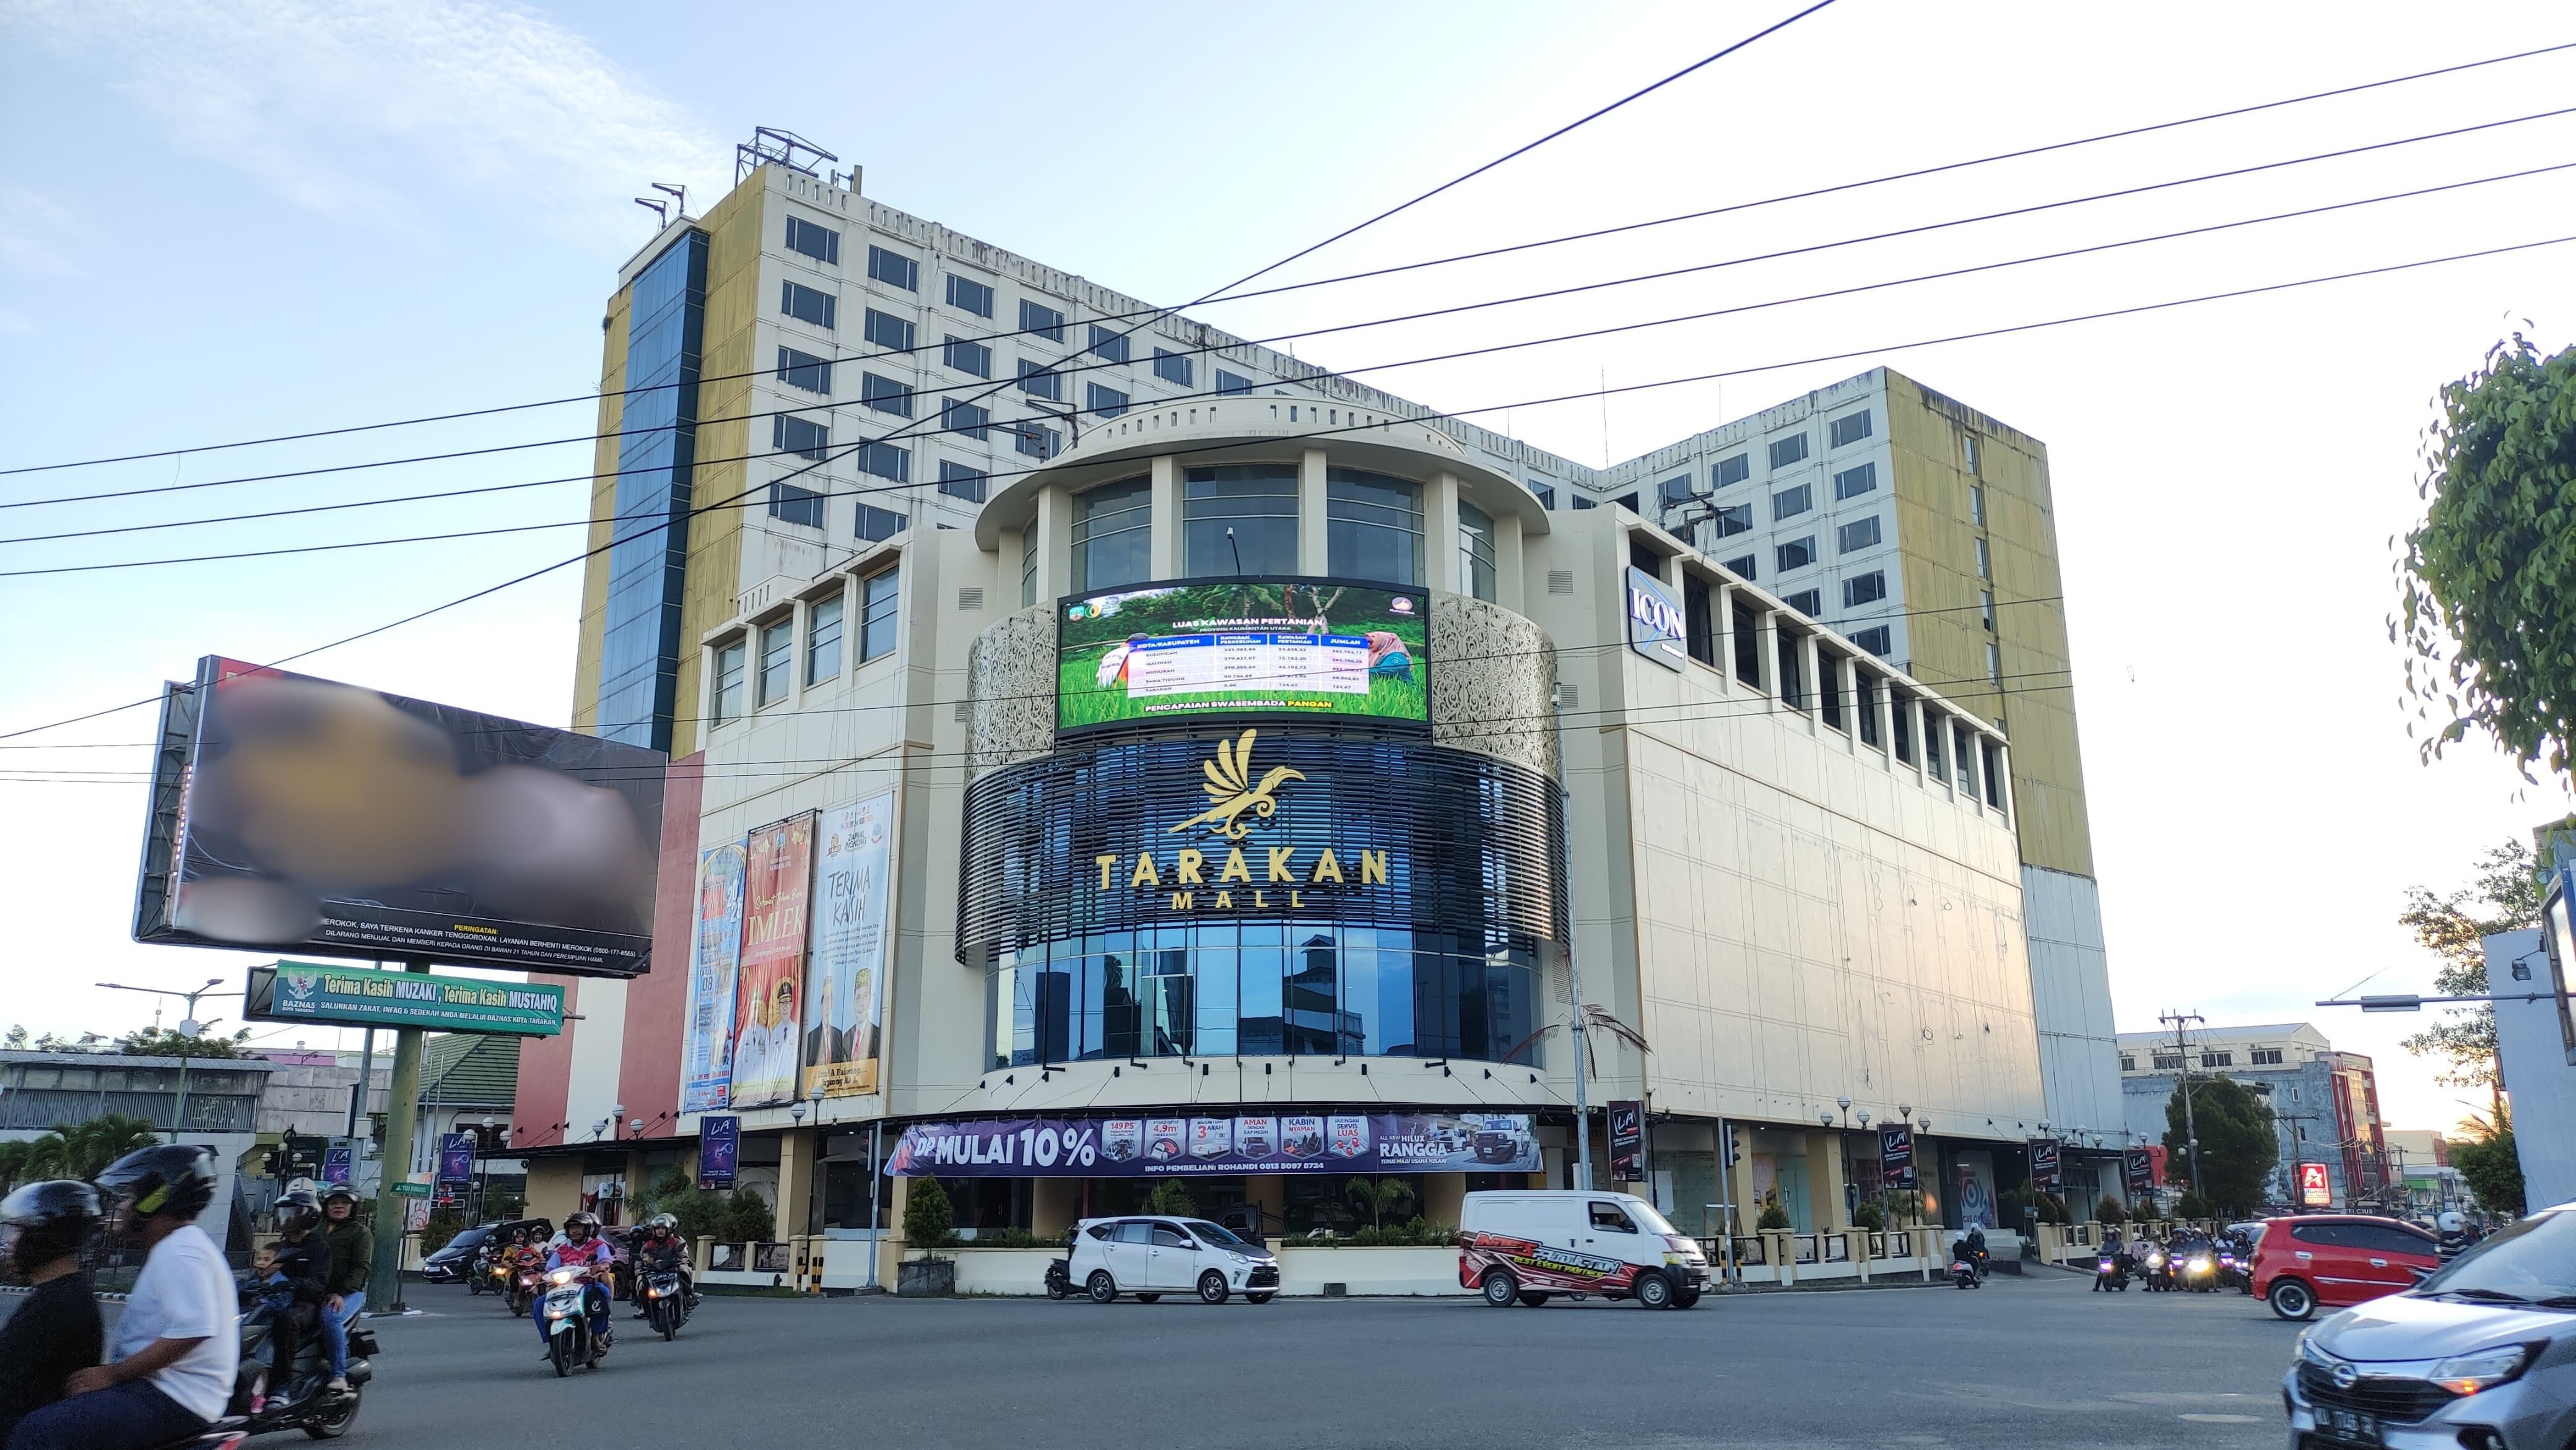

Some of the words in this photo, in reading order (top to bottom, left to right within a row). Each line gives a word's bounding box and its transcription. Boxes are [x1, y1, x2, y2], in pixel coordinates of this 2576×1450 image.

[1172, 620, 1199, 628] LUAS
[1201, 619, 1259, 627] KAWASAN
[1261, 618, 1323, 626] PERTANIAN
[1629, 587, 1686, 641] ICON
[1146, 701, 1209, 712] PENCAPAIAN
[1095, 846, 1387, 890] TARAKAN
[827, 865, 870, 899] TERIMA
[832, 894, 866, 926] KASIH
[1172, 890, 1305, 910] MALL
[324, 918, 359, 928] EROKOK,
[360, 922, 378, 931] SAYA
[380, 924, 413, 934] TERKENA
[414, 927, 443, 937] KANKER
[445, 931, 498, 943] TENGGOROKAN.
[500, 937, 528, 946] LAYANAN
[529, 940, 561, 949] BERHENTI
[562, 944, 593, 952] MEROKOK
[454, 924, 498, 935] PERINGATAN:
[747, 904, 806, 946] IMLEK
[326, 930, 360, 939] DILARANG
[361, 933, 391, 942] MENJUAL
[406, 937, 435, 946] MEMBERI
[437, 940, 461, 949] KEPADA
[492, 946, 512, 954] BAWAH
[553, 953, 586, 962] PEREMPUAN
[324, 974, 361, 996] Terima
[363, 977, 393, 998] Kasih
[444, 984, 477, 1005] Terima
[479, 988, 507, 1007] Kasih
[508, 990, 557, 1014] MUSTAHIQ
[282, 1000, 316, 1009] BAZNAS
[321, 1002, 357, 1010] SALURKAN
[359, 1005, 381, 1013] ZAKAT,
[383, 1006, 402, 1015] INFAQ
[410, 1009, 439, 1017] SEDEKAH
[459, 1012, 486, 1020] MELALUI
[487, 1014, 511, 1022] BAZNAS
[529, 1017, 556, 1025] TARAKAN
[1110, 1122, 1123, 1130] 149
[1198, 1126, 1206, 1139] 3
[914, 1137, 936, 1157] DP
[935, 1134, 1016, 1165] MULAI
[1019, 1128, 1095, 1167] 10%
[1401, 1134, 1425, 1142] HILUX
[1380, 1143, 1448, 1157] RANGGA
[1166, 1164, 1217, 1172] PEMBELIAN:
[1218, 1163, 1258, 1171] ROHANDI
[1513, 1256, 1535, 1265] BEST
[1537, 1259, 1564, 1270] EVENT
